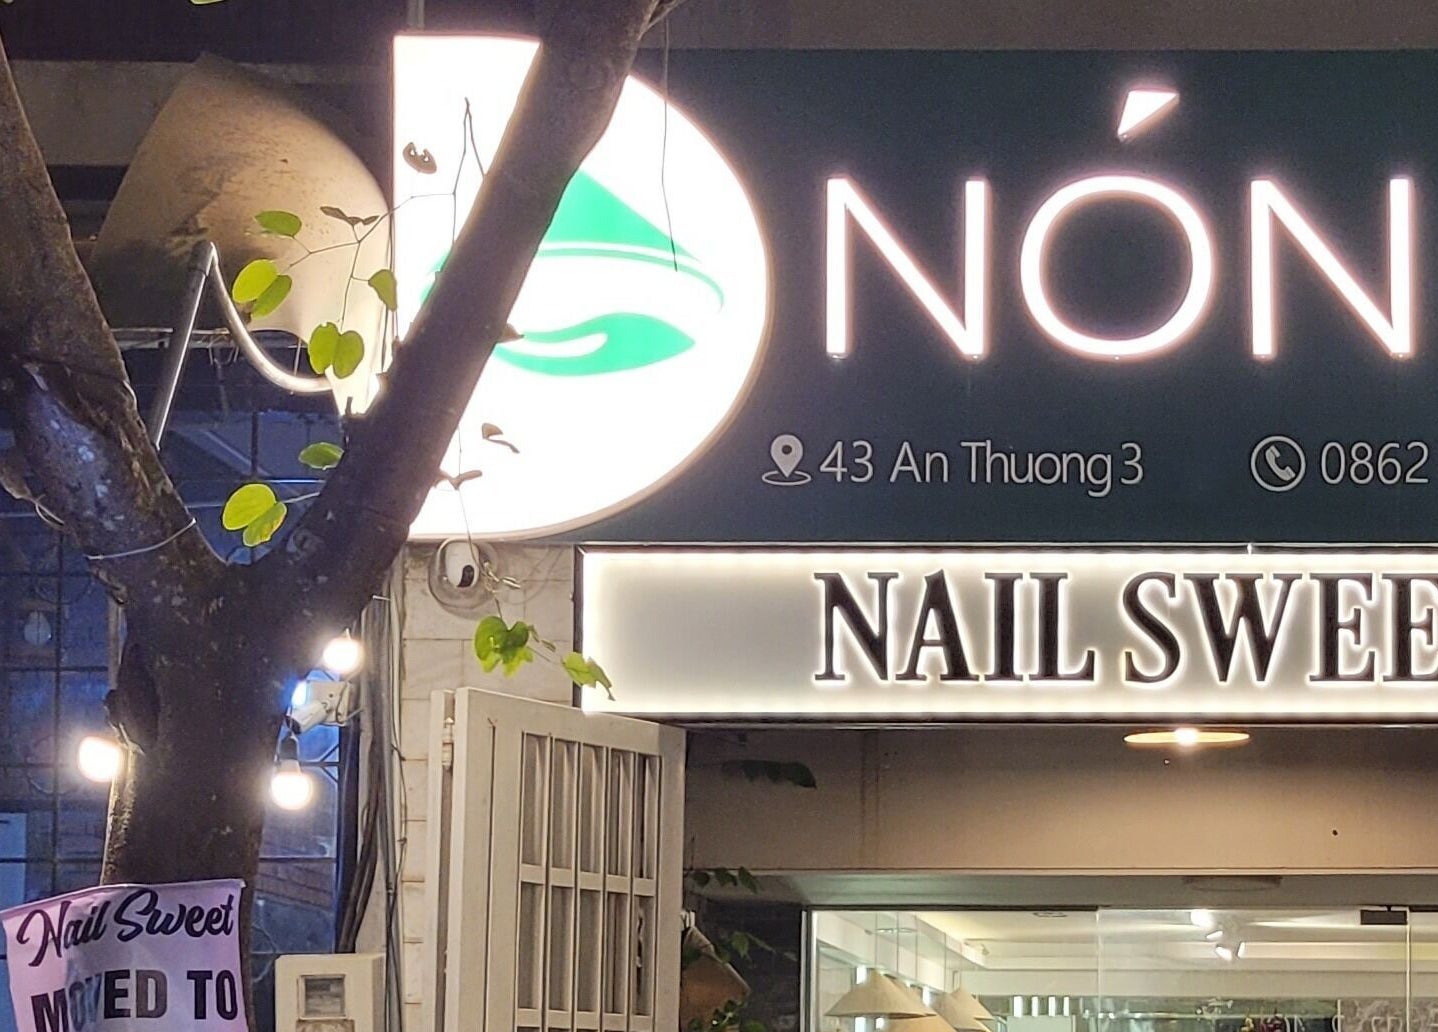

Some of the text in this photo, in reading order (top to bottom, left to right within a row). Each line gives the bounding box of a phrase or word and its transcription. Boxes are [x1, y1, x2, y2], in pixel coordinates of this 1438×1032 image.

[824, 88, 1414, 360] NÓN
[820, 440, 873, 483] 43
[890, 441, 949, 483] An
[960, 440, 1112, 498] Thuong
[1321, 441, 1429, 485] 0862
[814, 570, 1095, 682] NAIL
[16, 886, 235, 968] Nail Sweet
[187, 969, 238, 1021] TO
